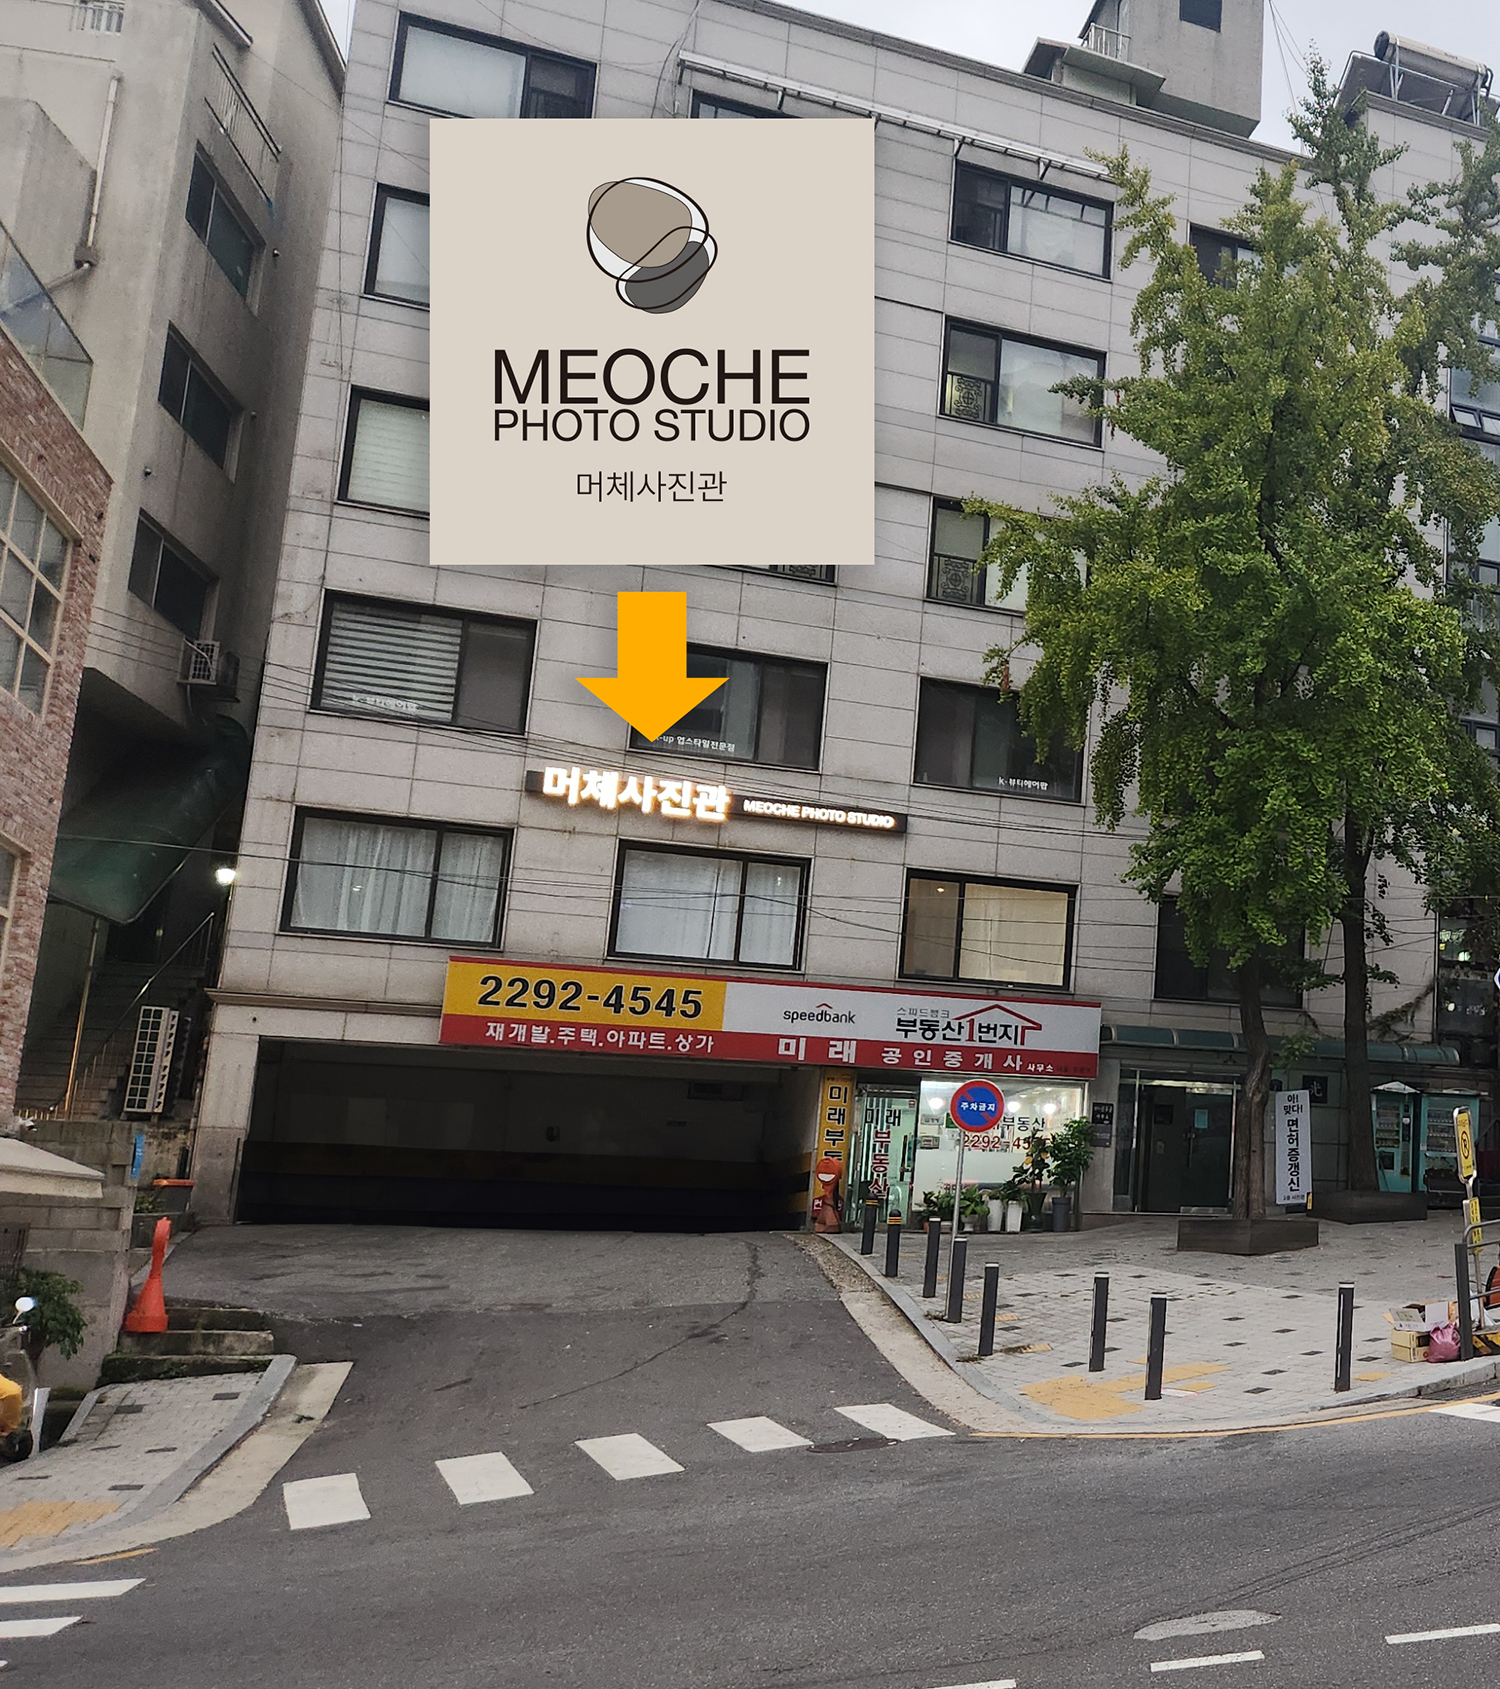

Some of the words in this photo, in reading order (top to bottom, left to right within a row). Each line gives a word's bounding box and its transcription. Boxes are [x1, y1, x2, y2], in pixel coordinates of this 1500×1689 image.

[676, 735, 735, 752] 업스타일전문점
[543, 766, 730, 821] 머체사진관
[743, 800, 801, 818] MEOCHE
[801, 806, 845, 823] PHOTO
[846, 812, 895, 828] STUDIO
[477, 975, 703, 1019] 2292-4545
[783, 1009, 856, 1024] speedbank
[895, 1017, 1020, 1046] 부동산1번지
[778, 1037, 857, 1063] 미래
[881, 1046, 1023, 1071] 공인중개사
[1026, 1062, 1054, 1073] 사무소
[960, 1101, 996, 1112] 주차금지
[1283, 1104, 1303, 1116] 맞다!
[1287, 1094, 1299, 1104] 아!
[865, 1108, 901, 1127] 미래
[868, 1130, 892, 1199] 부동산
[1286, 1118, 1300, 1193] 면허증갱신
